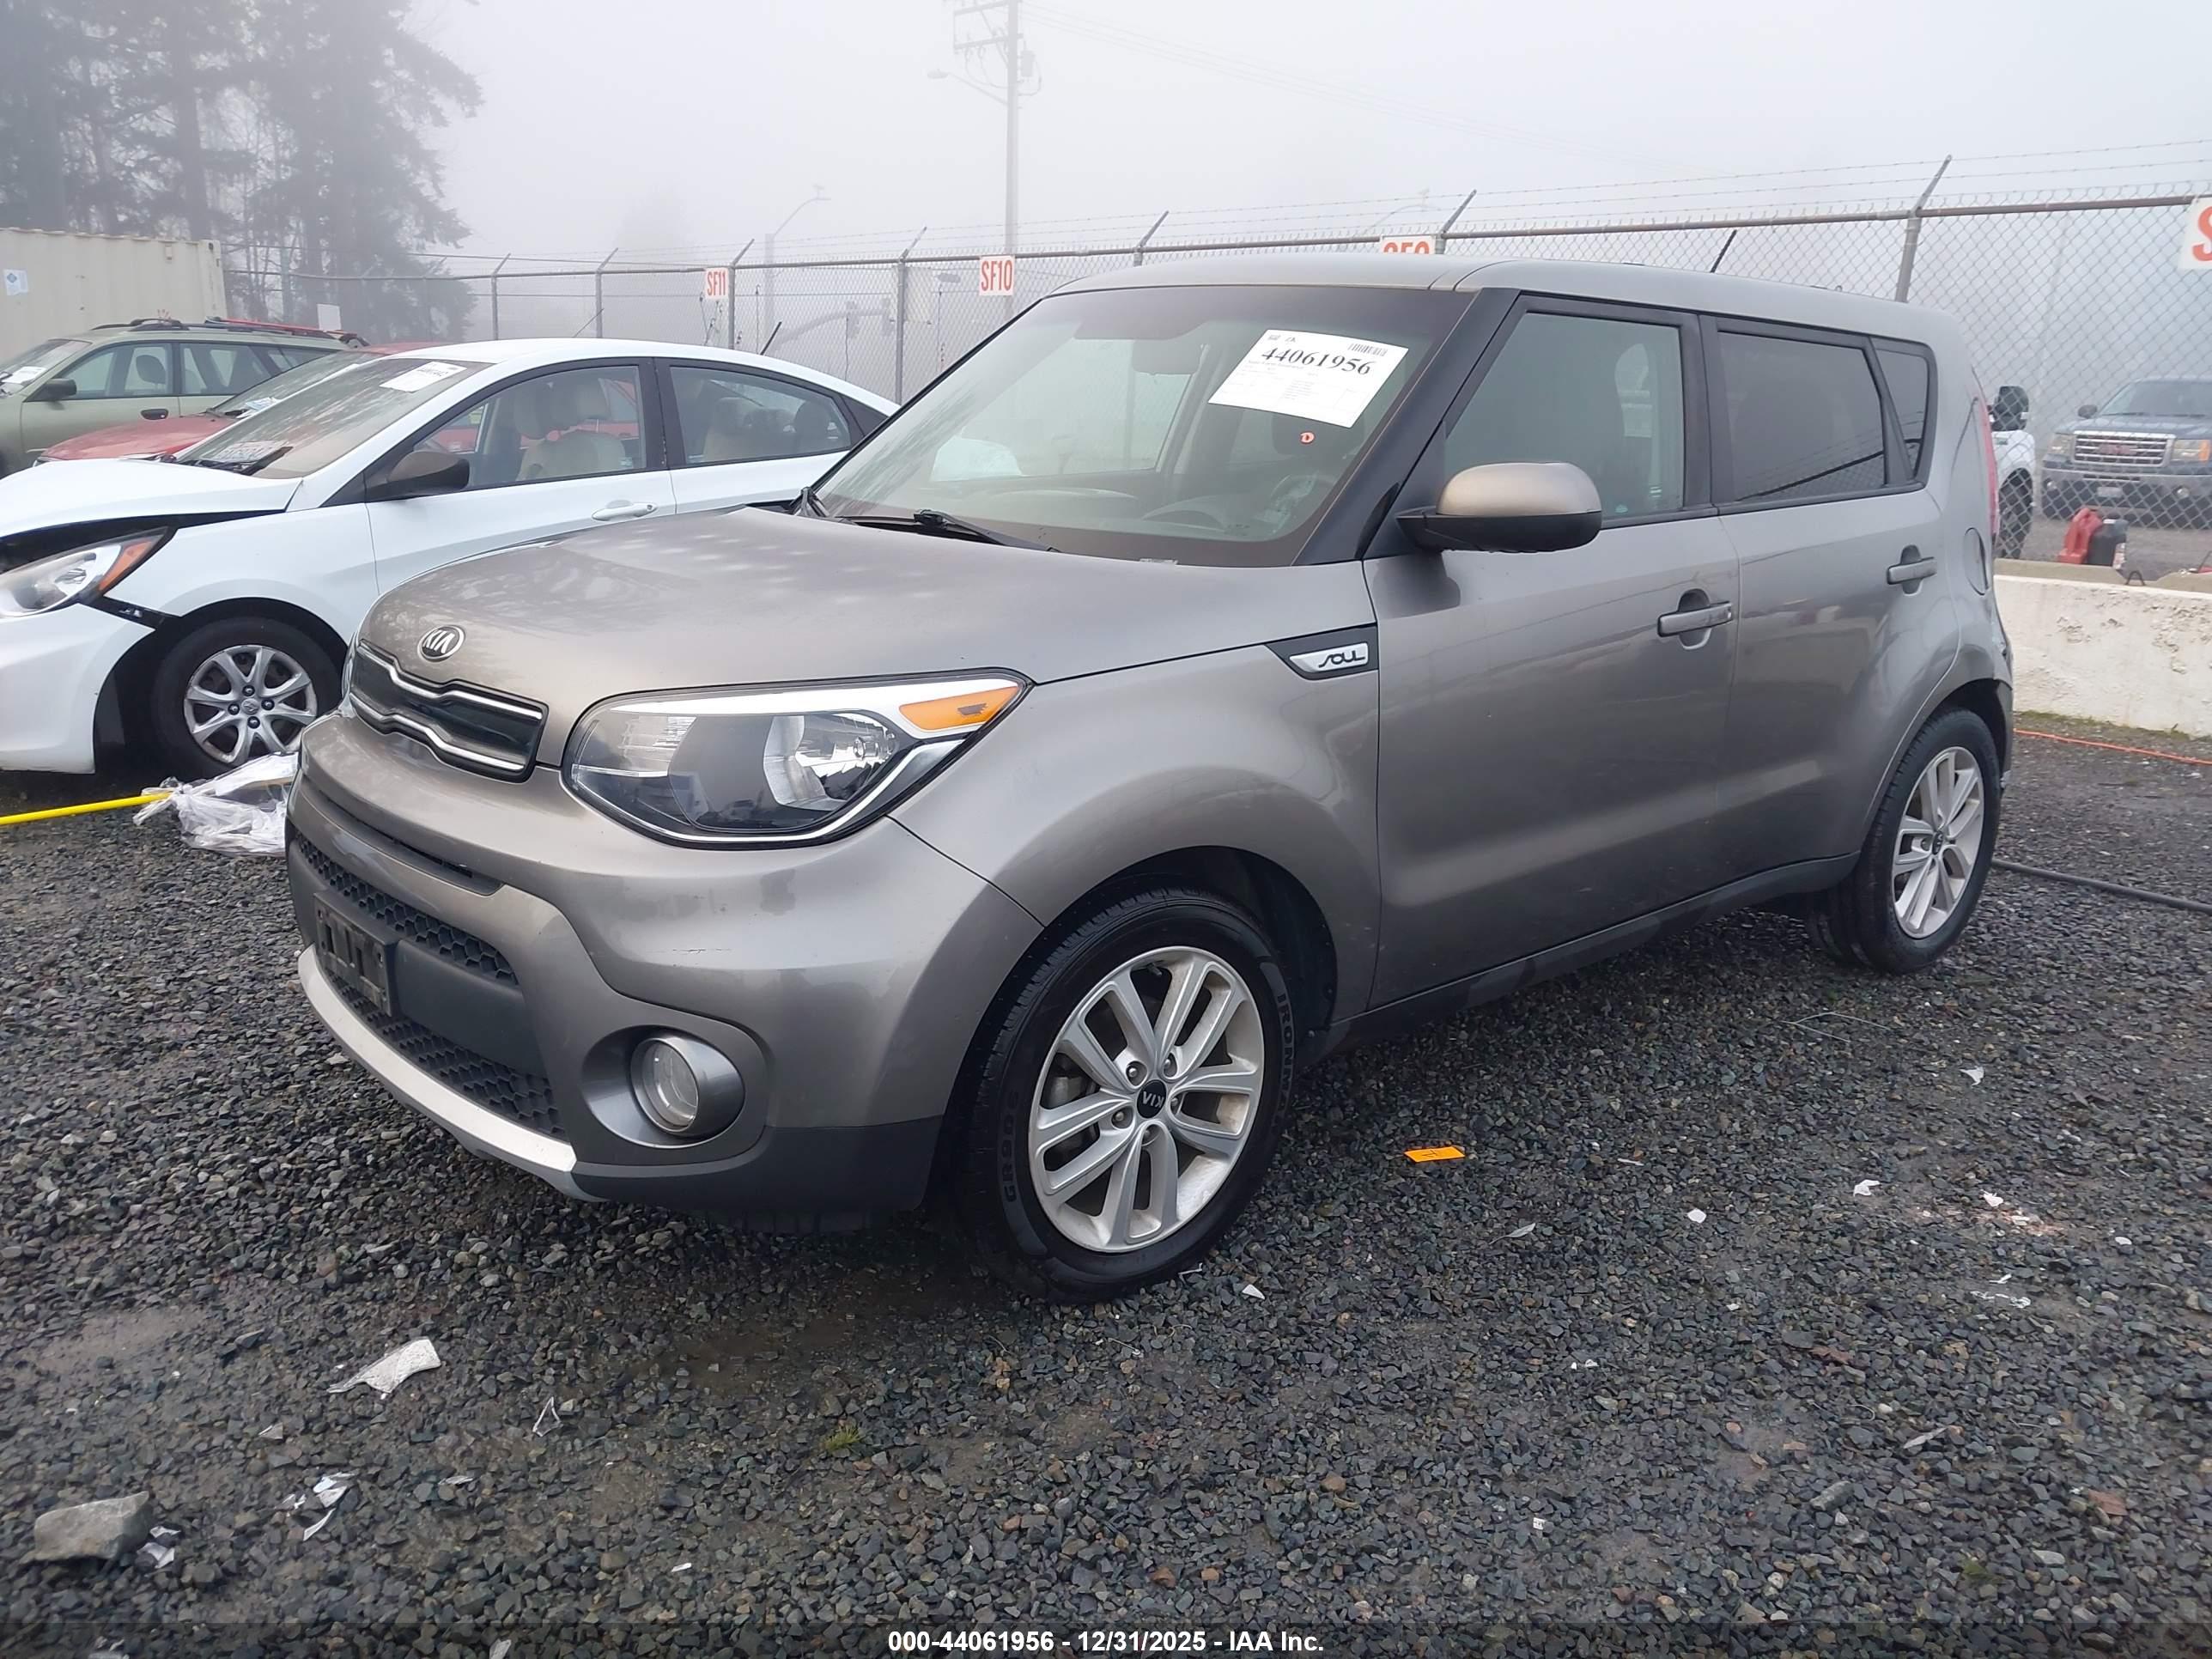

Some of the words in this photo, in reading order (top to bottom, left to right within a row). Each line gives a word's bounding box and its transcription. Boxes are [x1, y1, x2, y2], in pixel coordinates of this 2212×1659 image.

[707, 271, 726, 296] SF11
[981, 260, 1012, 291] SF10
[1261, 347, 1377, 375] 44061956
[422, 629, 456, 654] KIA
[1318, 650, 1365, 668] SOUL
[1143, 1091, 1165, 1109] KIA
